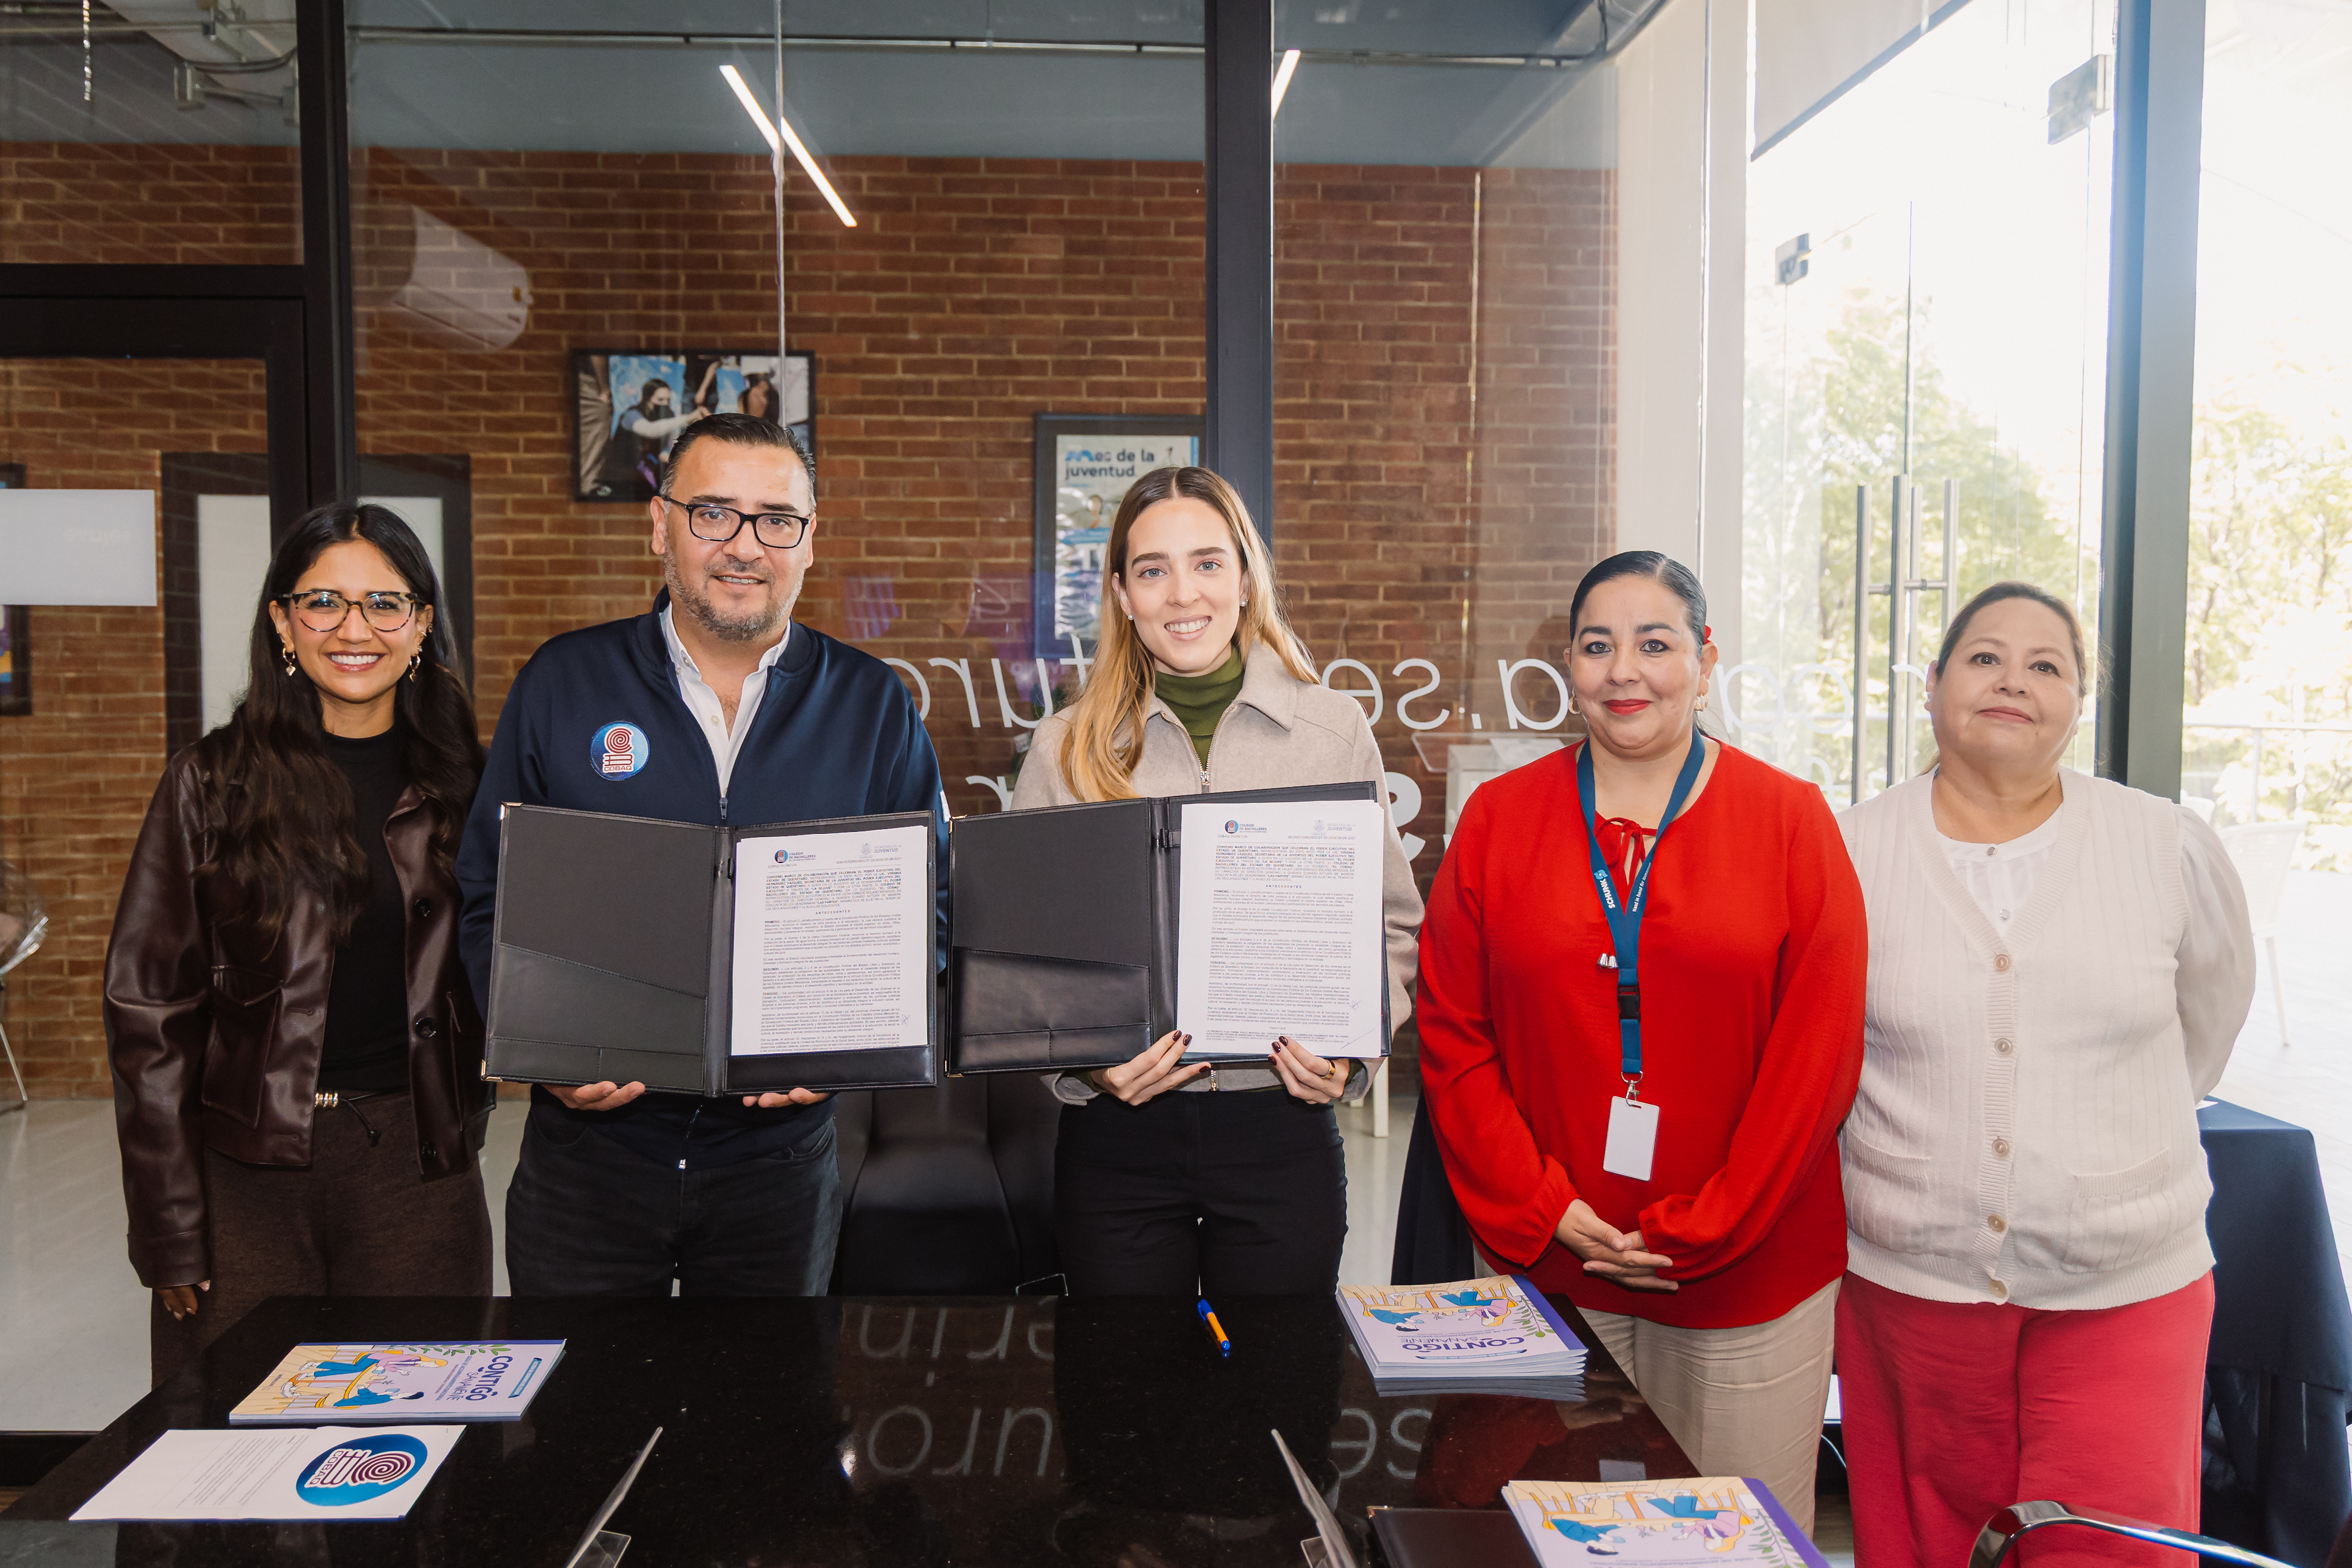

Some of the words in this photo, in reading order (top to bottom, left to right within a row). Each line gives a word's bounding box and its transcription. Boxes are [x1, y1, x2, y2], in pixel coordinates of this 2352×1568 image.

[1117, 449, 1136, 462] de
[1141, 448, 1155, 462] la
[1065, 465, 1136, 479] juventud
[1642, 862, 1652, 881] tomorrow
[1600, 878, 1616, 908] SCHUNK
[1402, 1337, 1525, 1352] CONTIGO
[446, 1372, 478, 1400] SANAMENTE
[465, 1356, 513, 1401] CONTIGO
[309, 1450, 344, 1485] COBAQ
